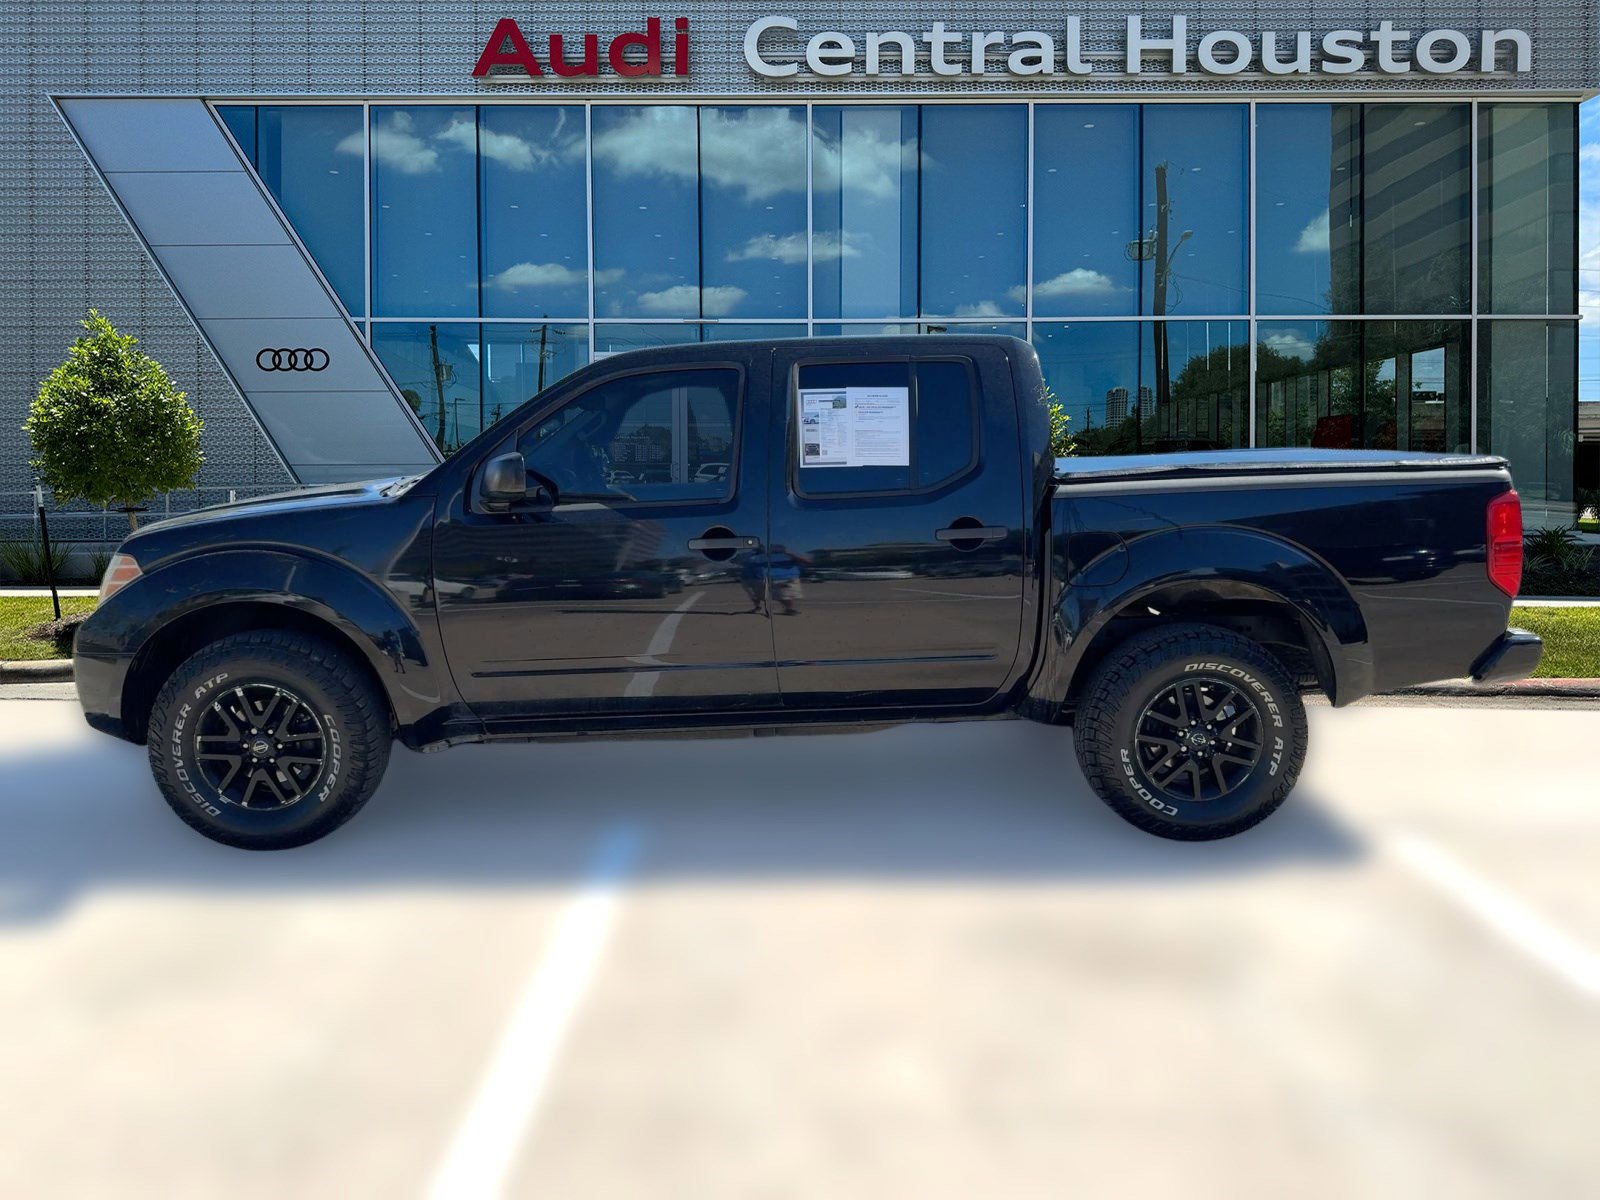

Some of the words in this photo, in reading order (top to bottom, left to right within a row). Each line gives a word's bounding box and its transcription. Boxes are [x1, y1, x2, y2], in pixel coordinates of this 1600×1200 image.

[472, 16, 690, 78] Audi
[744, 15, 1092, 78] Central
[1126, 15, 1532, 76] Houston
[194, 672, 229, 699] ATP
[1184, 662, 1284, 728] DISCOVERER
[1269, 736, 1284, 777] ATP
[171, 703, 222, 817] DISCOVERER
[317, 714, 342, 803] COOPER
[1120, 748, 1179, 817] COOPER
